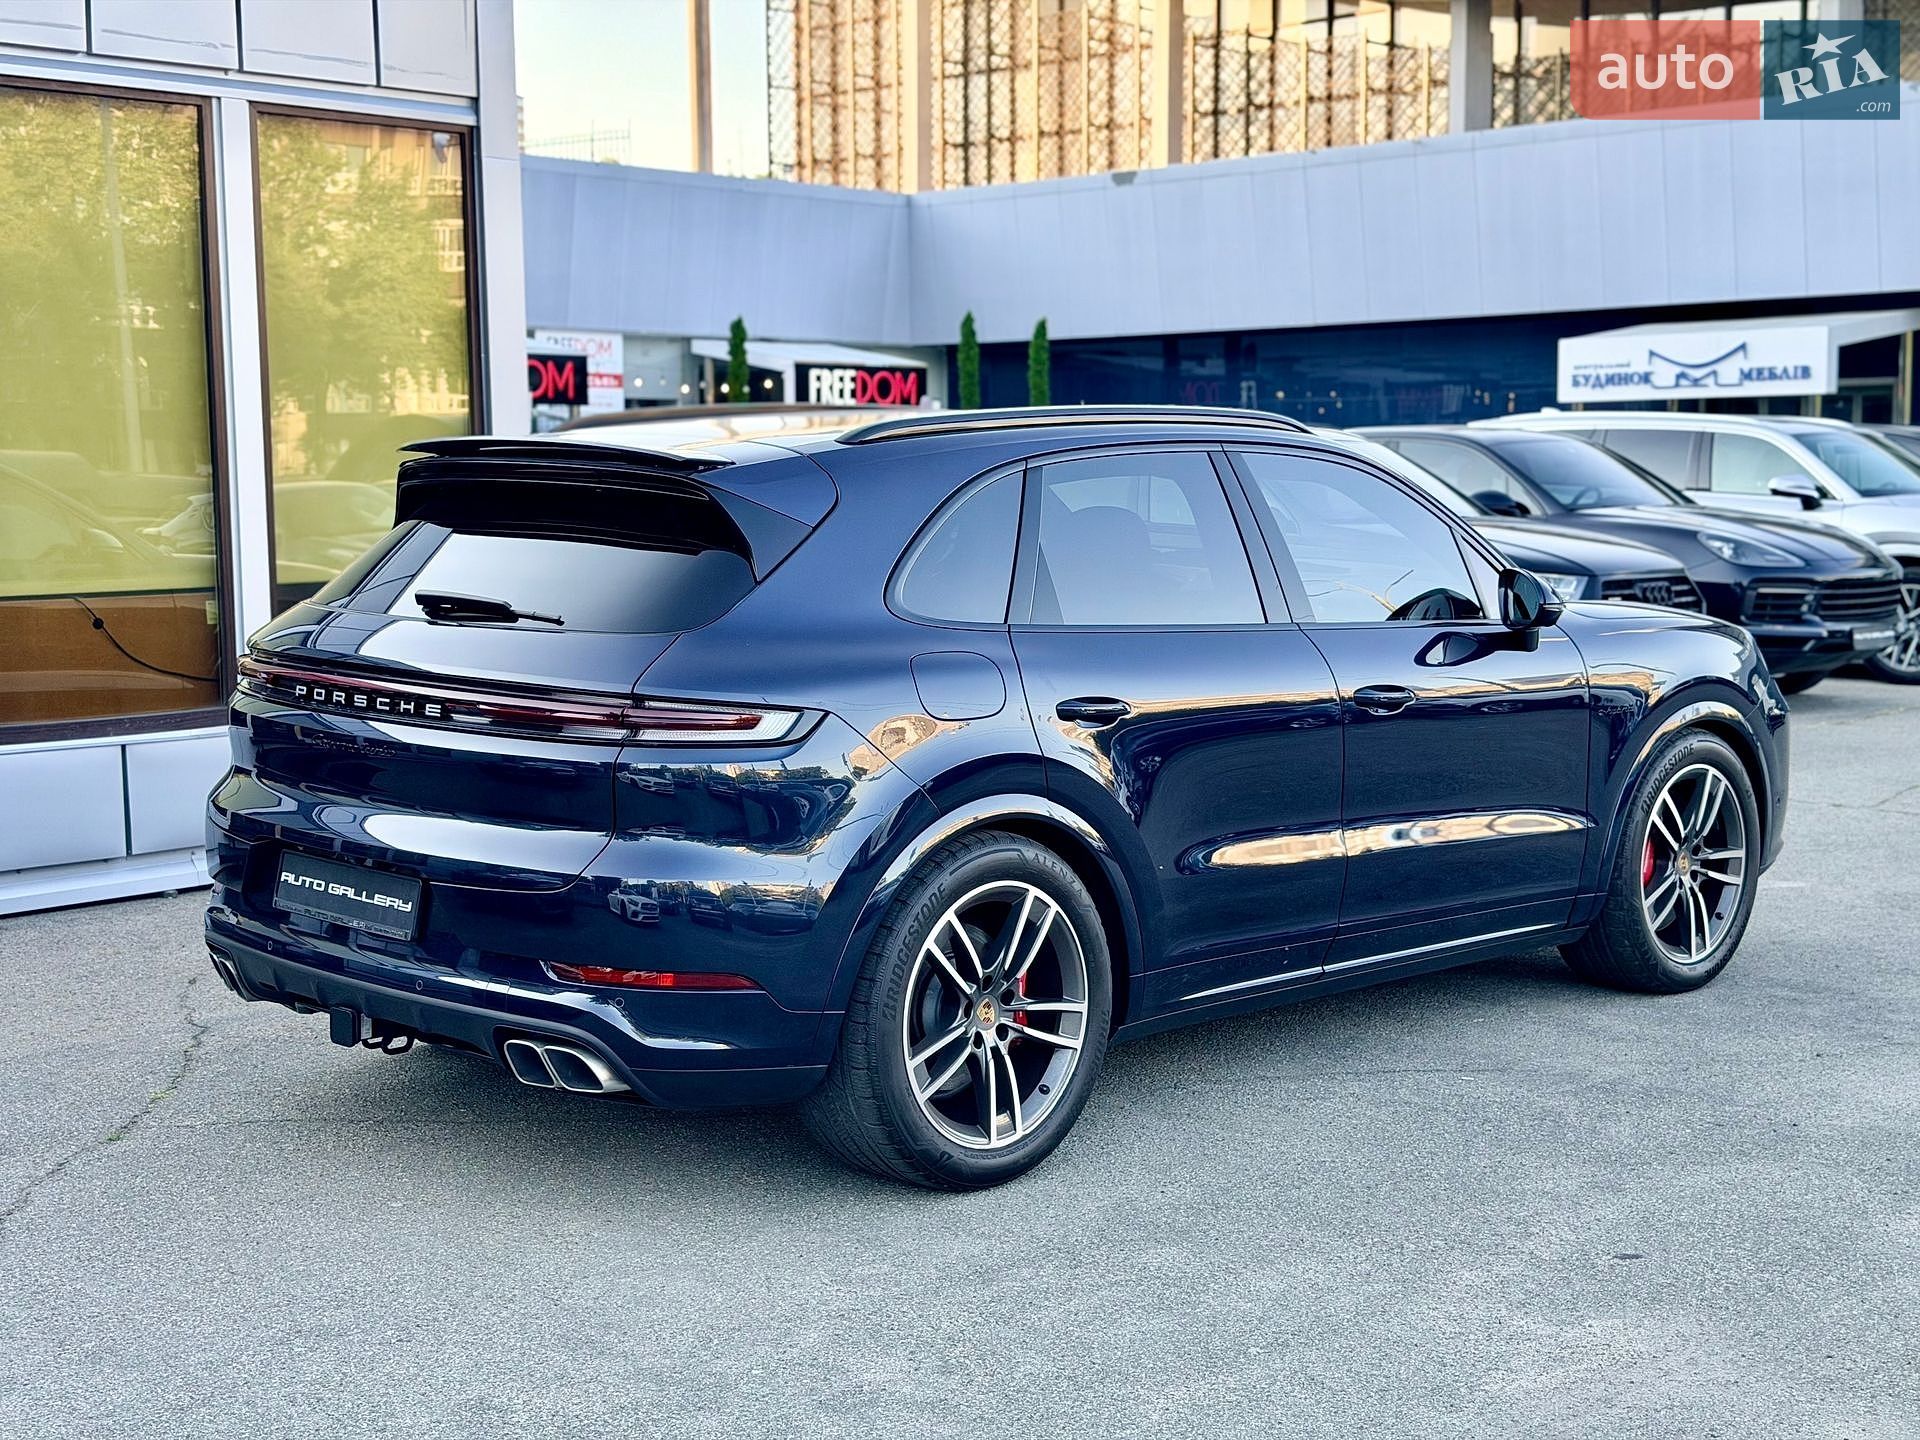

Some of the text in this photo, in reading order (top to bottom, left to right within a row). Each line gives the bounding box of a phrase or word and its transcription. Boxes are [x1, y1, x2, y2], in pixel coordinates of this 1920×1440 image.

[808, 367, 918, 406] FREEDOM
[1571, 365, 1811, 389] БУДИНОК МЕБЛІВ
[295, 685, 442, 717] PORSCHE
[280, 871, 326, 892] AUTO
[327, 882, 413, 912] GALLERY
